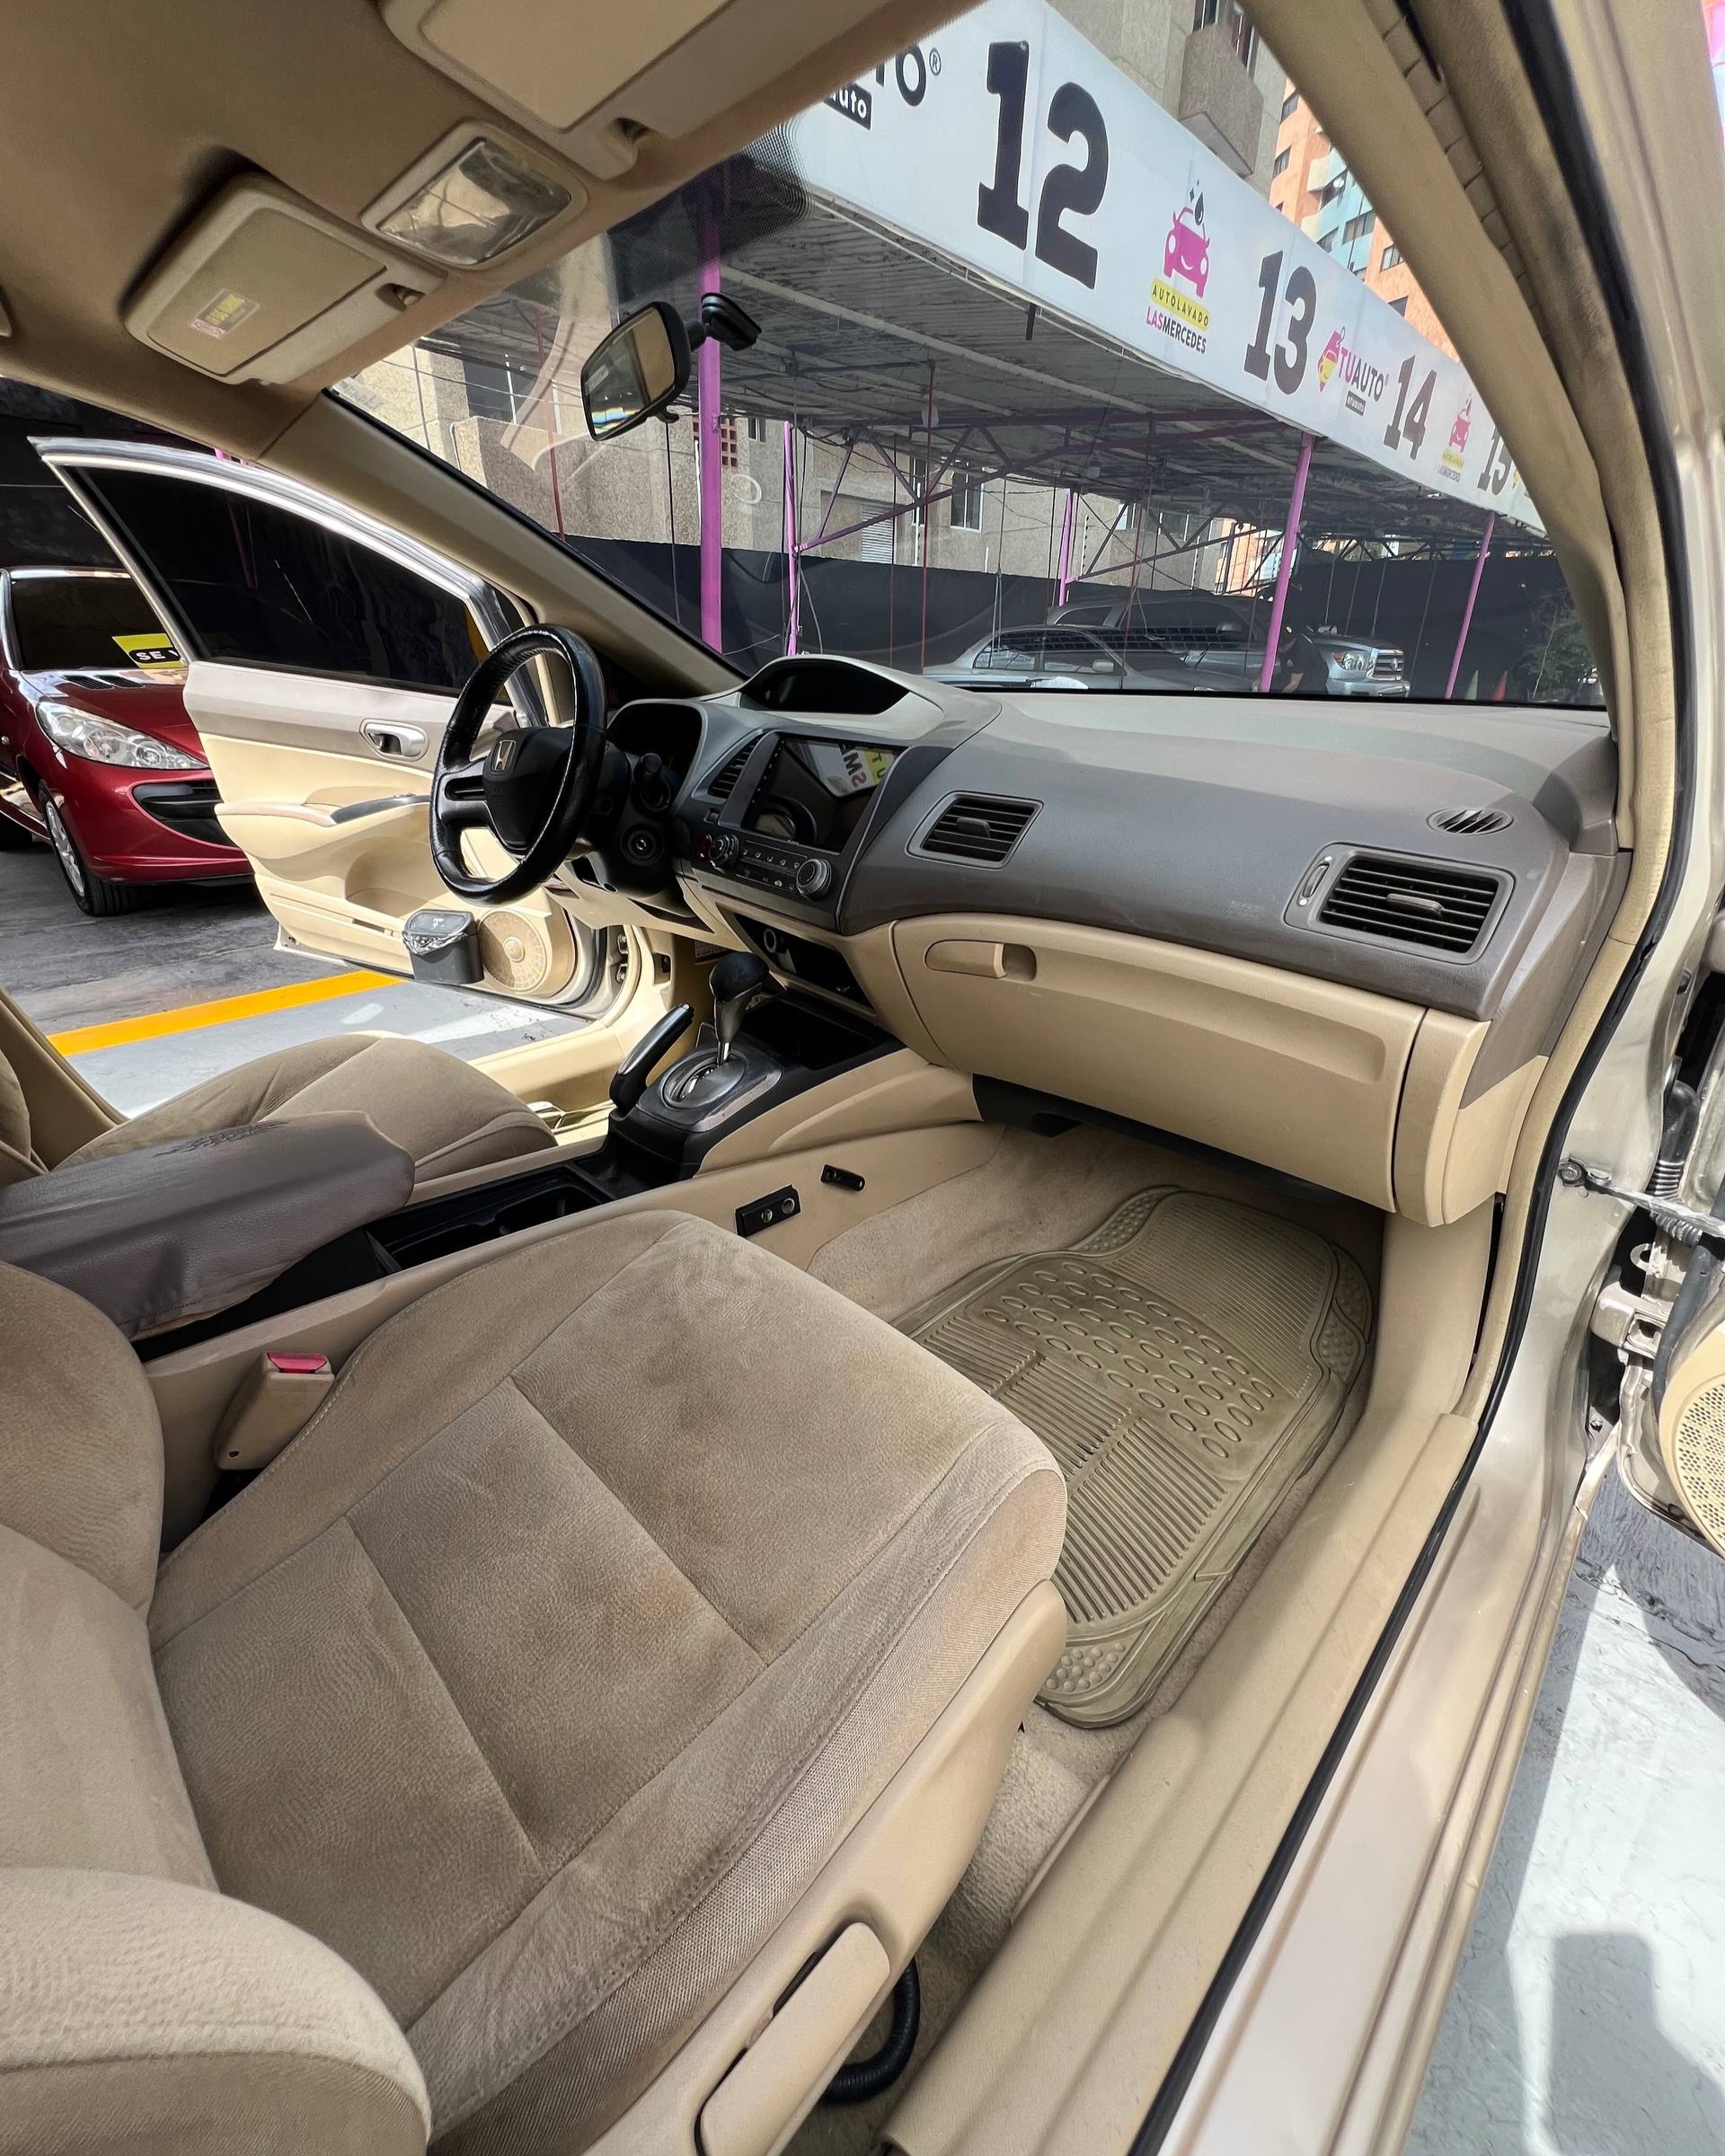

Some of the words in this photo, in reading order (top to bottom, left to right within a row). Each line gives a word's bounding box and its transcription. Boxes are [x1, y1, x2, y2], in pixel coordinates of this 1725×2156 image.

[977, 40, 1109, 290] 12
[1146, 305, 1207, 354] LASMERCEDES
[1152, 284, 1208, 327] AUTOLAVADO
[1243, 251, 1317, 395] 13
[1384, 355, 1438, 461] 14
[1477, 425, 1513, 496] 15
[136, 650, 166, 661] SE
